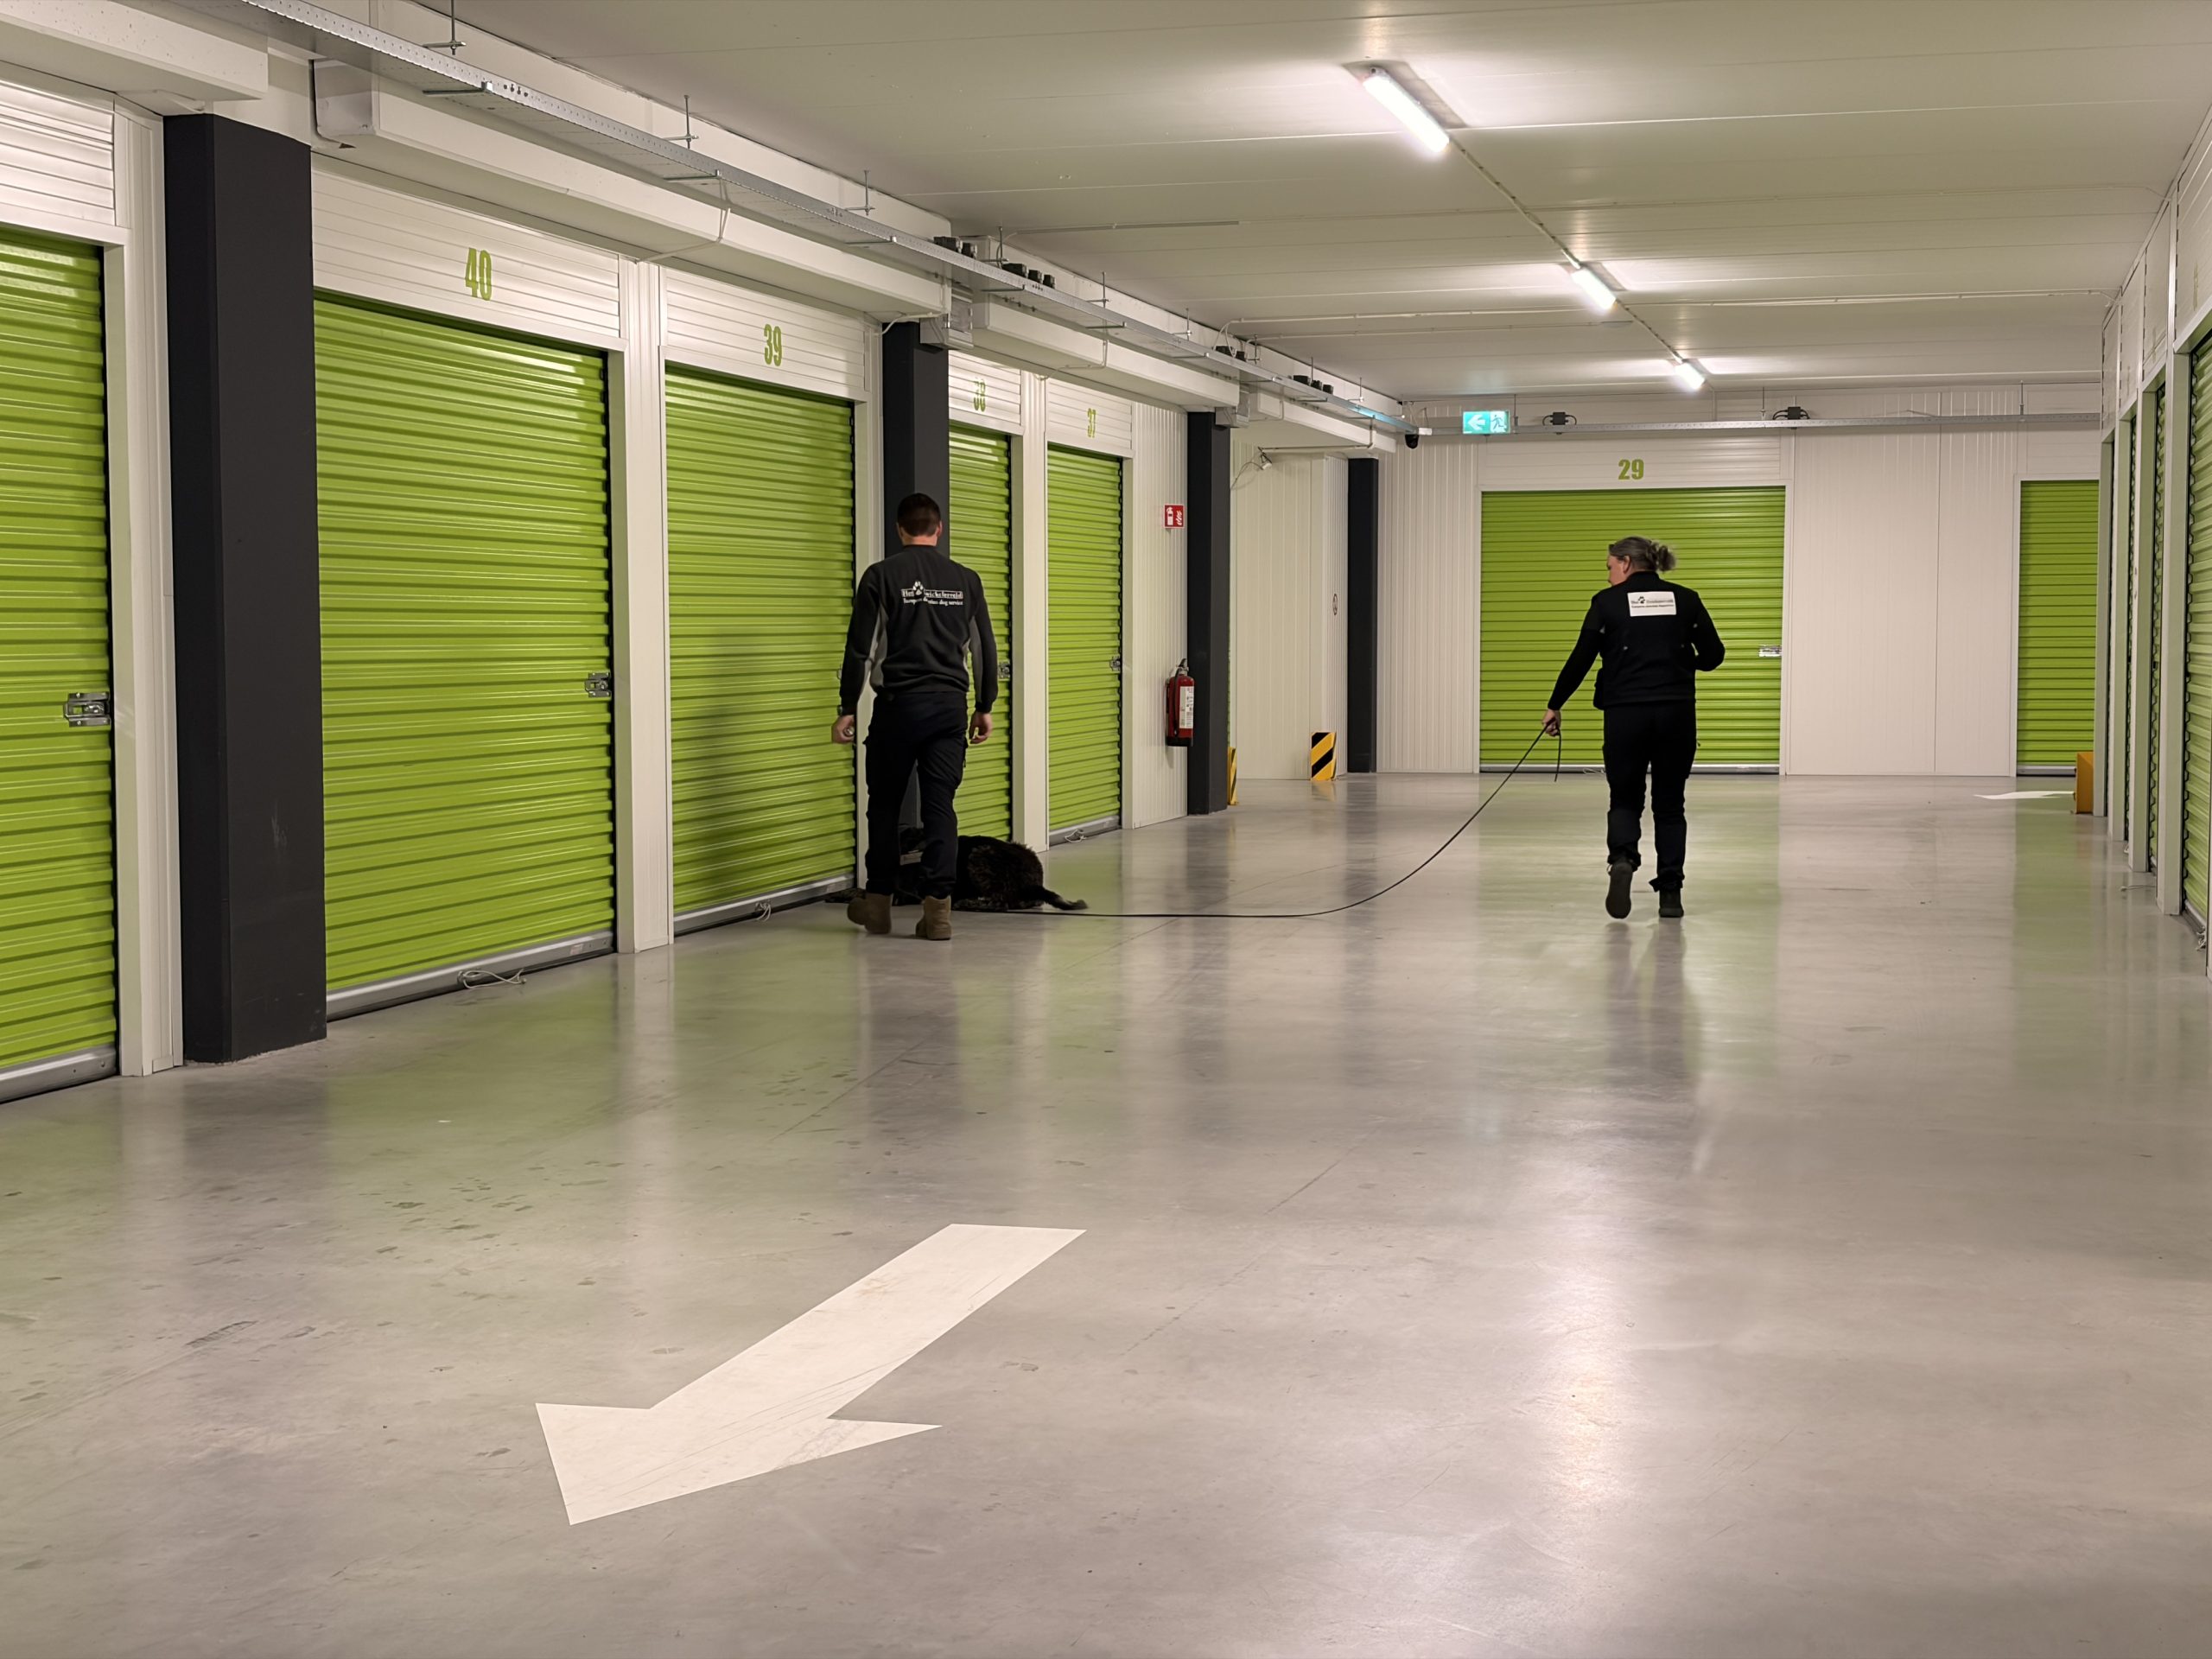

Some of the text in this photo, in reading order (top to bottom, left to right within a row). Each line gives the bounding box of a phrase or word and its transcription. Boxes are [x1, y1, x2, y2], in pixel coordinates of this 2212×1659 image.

[465, 247, 493, 301] 40
[764, 324, 782, 366] 39
[1088, 408, 1096, 438] 37
[1618, 459, 1645, 480] 29
